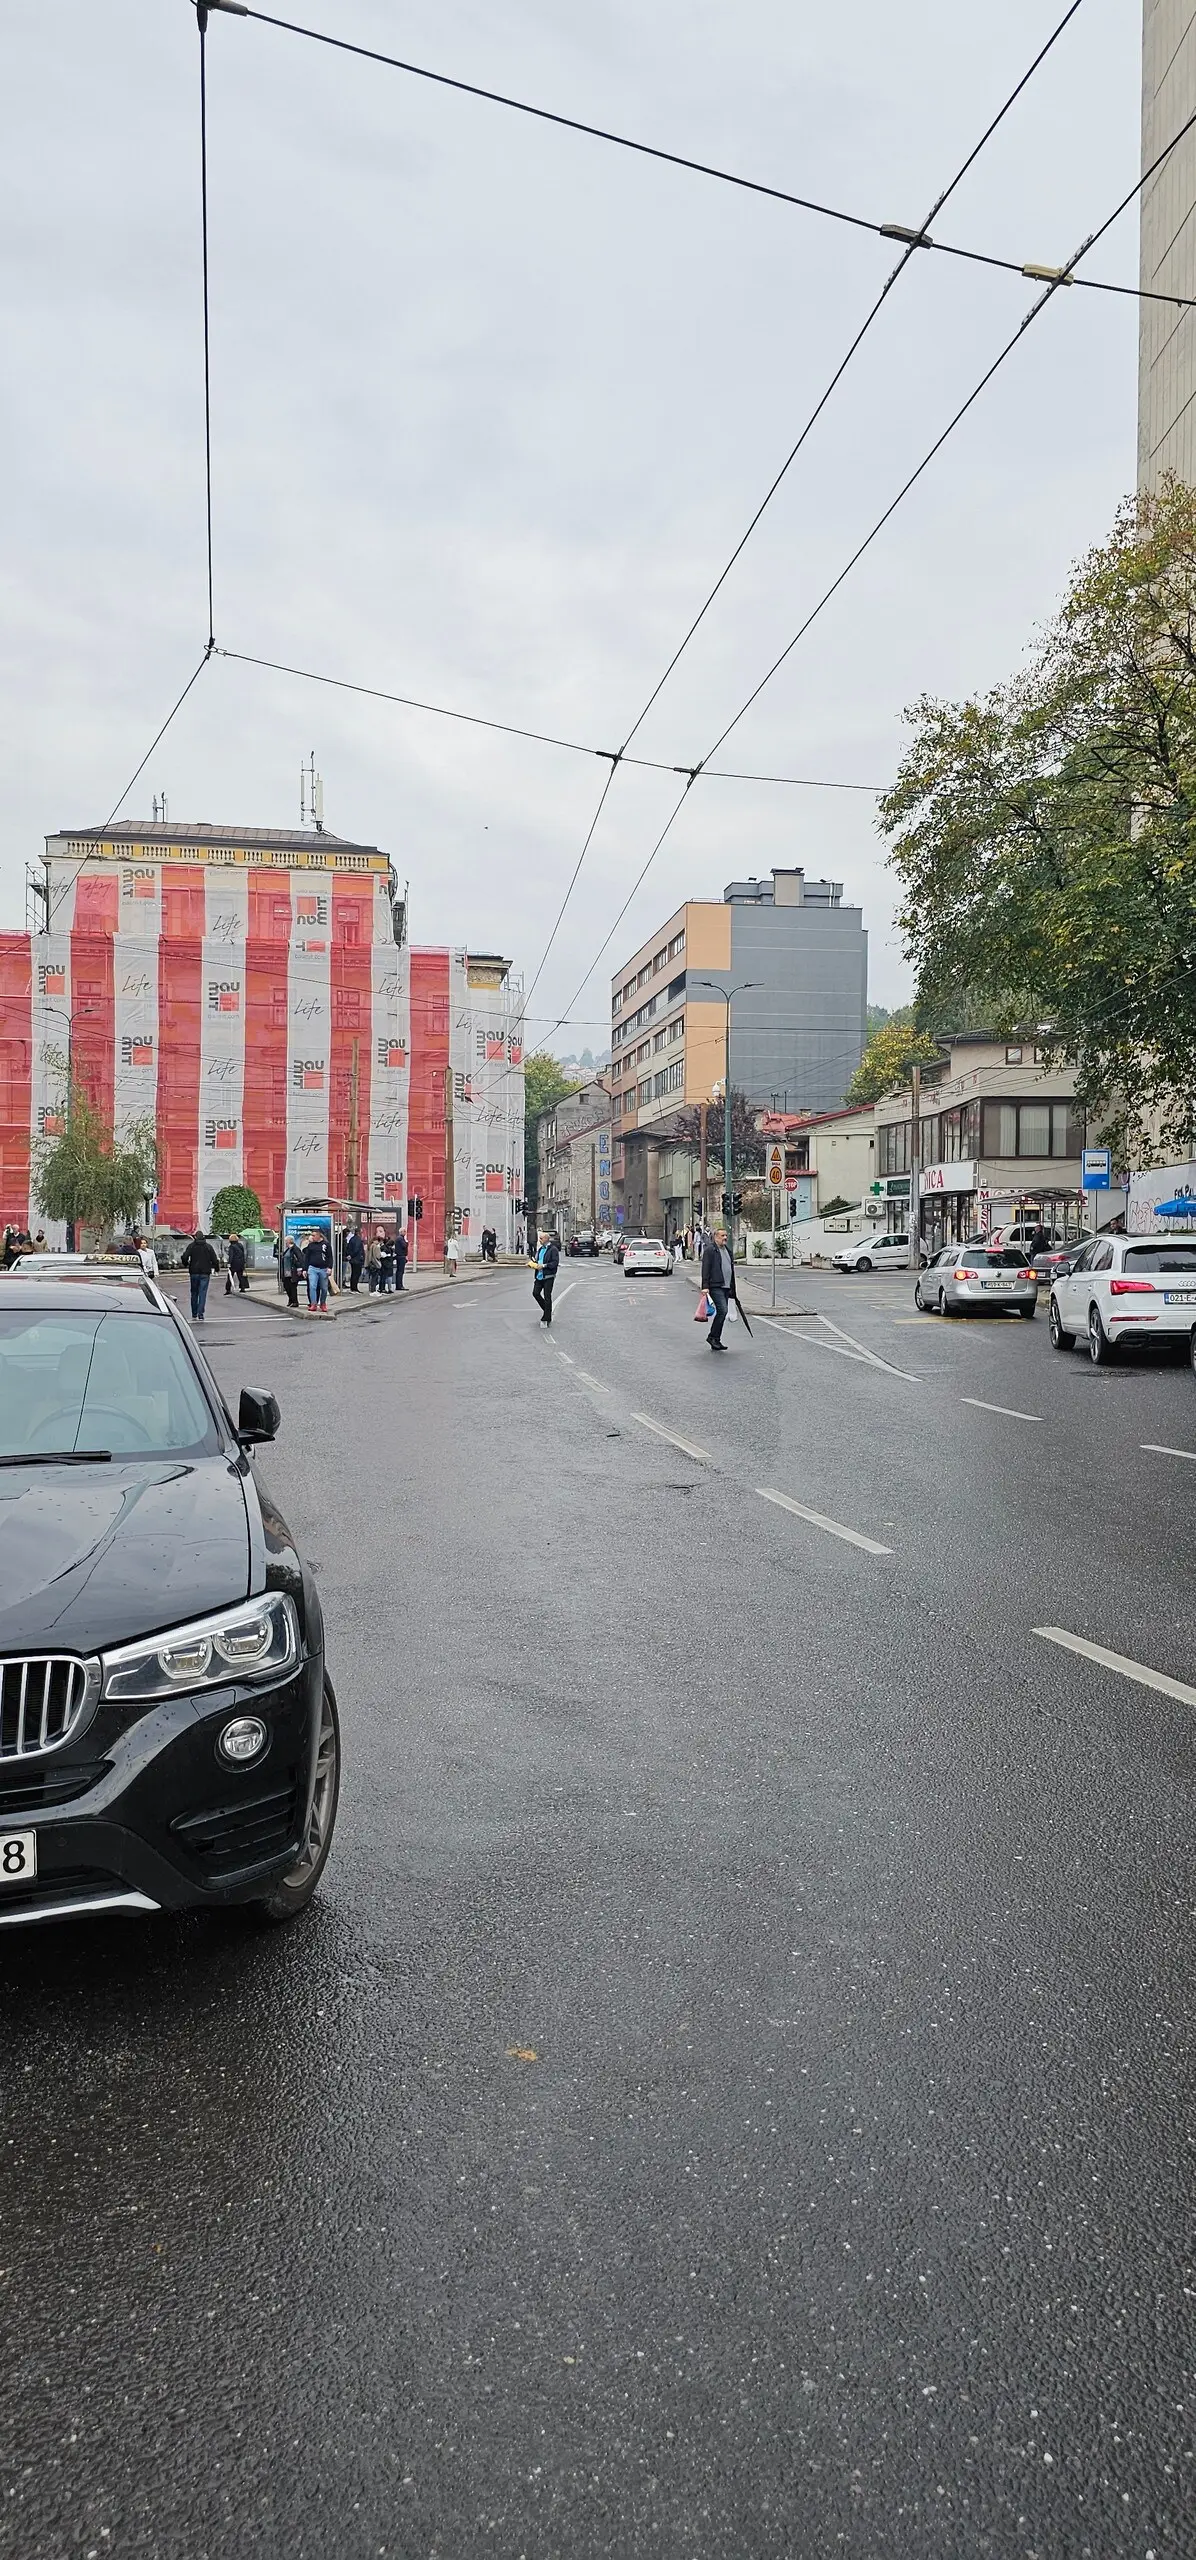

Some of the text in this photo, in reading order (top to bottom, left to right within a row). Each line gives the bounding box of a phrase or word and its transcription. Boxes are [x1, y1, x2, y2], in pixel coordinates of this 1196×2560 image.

[122, 974, 153, 996] Life
[294, 998, 325, 1020] Life
[208, 1058, 239, 1080] Life
[293, 1136, 324, 1157] Life
[771, 1170, 780, 1180] 40
[2, 1840, 26, 1874] 8
